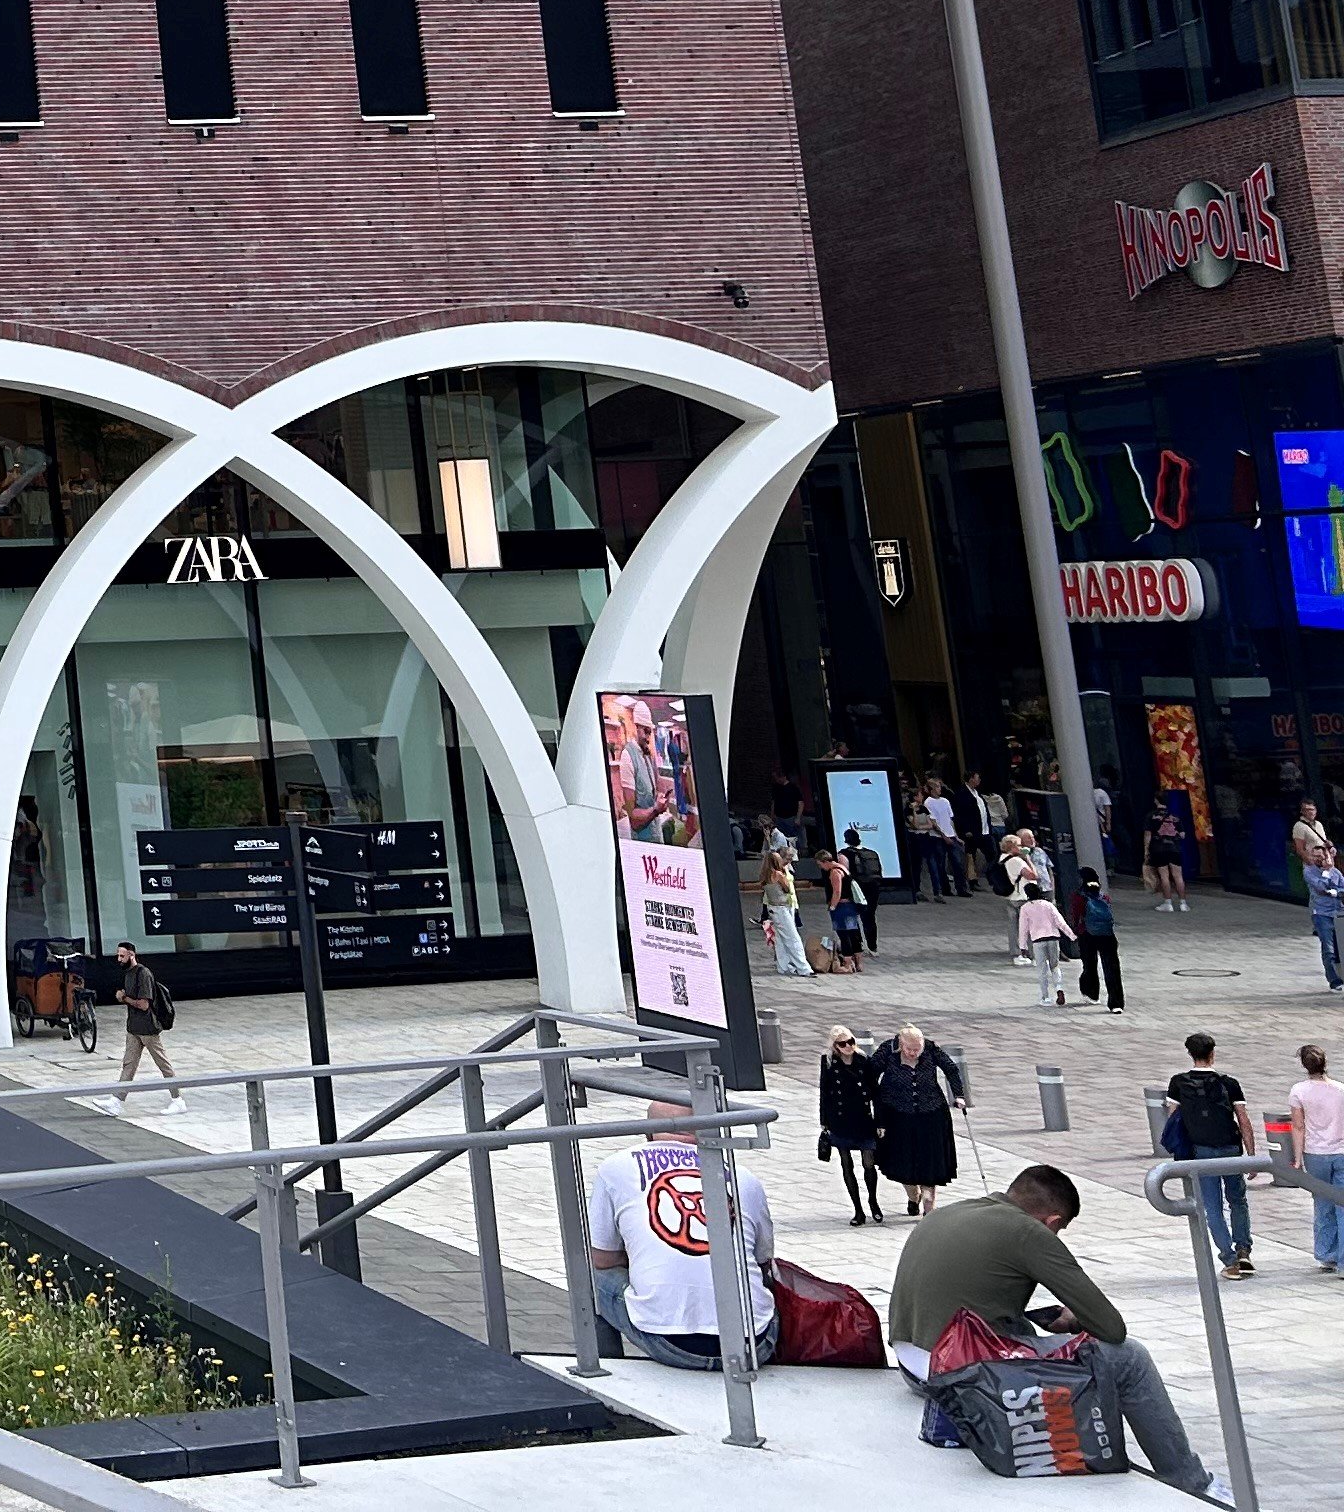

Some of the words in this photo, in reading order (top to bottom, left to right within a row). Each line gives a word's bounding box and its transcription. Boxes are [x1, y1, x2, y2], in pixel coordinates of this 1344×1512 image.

[1115, 162, 1289, 300] KINOPOLIS
[164, 534, 269, 584] ZARA
[1059, 561, 1191, 620] HARIBO
[1272, 714, 1344, 737] HAIBO
[641, 855, 687, 890] Westfield
[632, 1148, 702, 1192] THOUG
[1002, 1385, 1063, 1477] NIPES
[1041, 1386, 1093, 1477] NOWS
